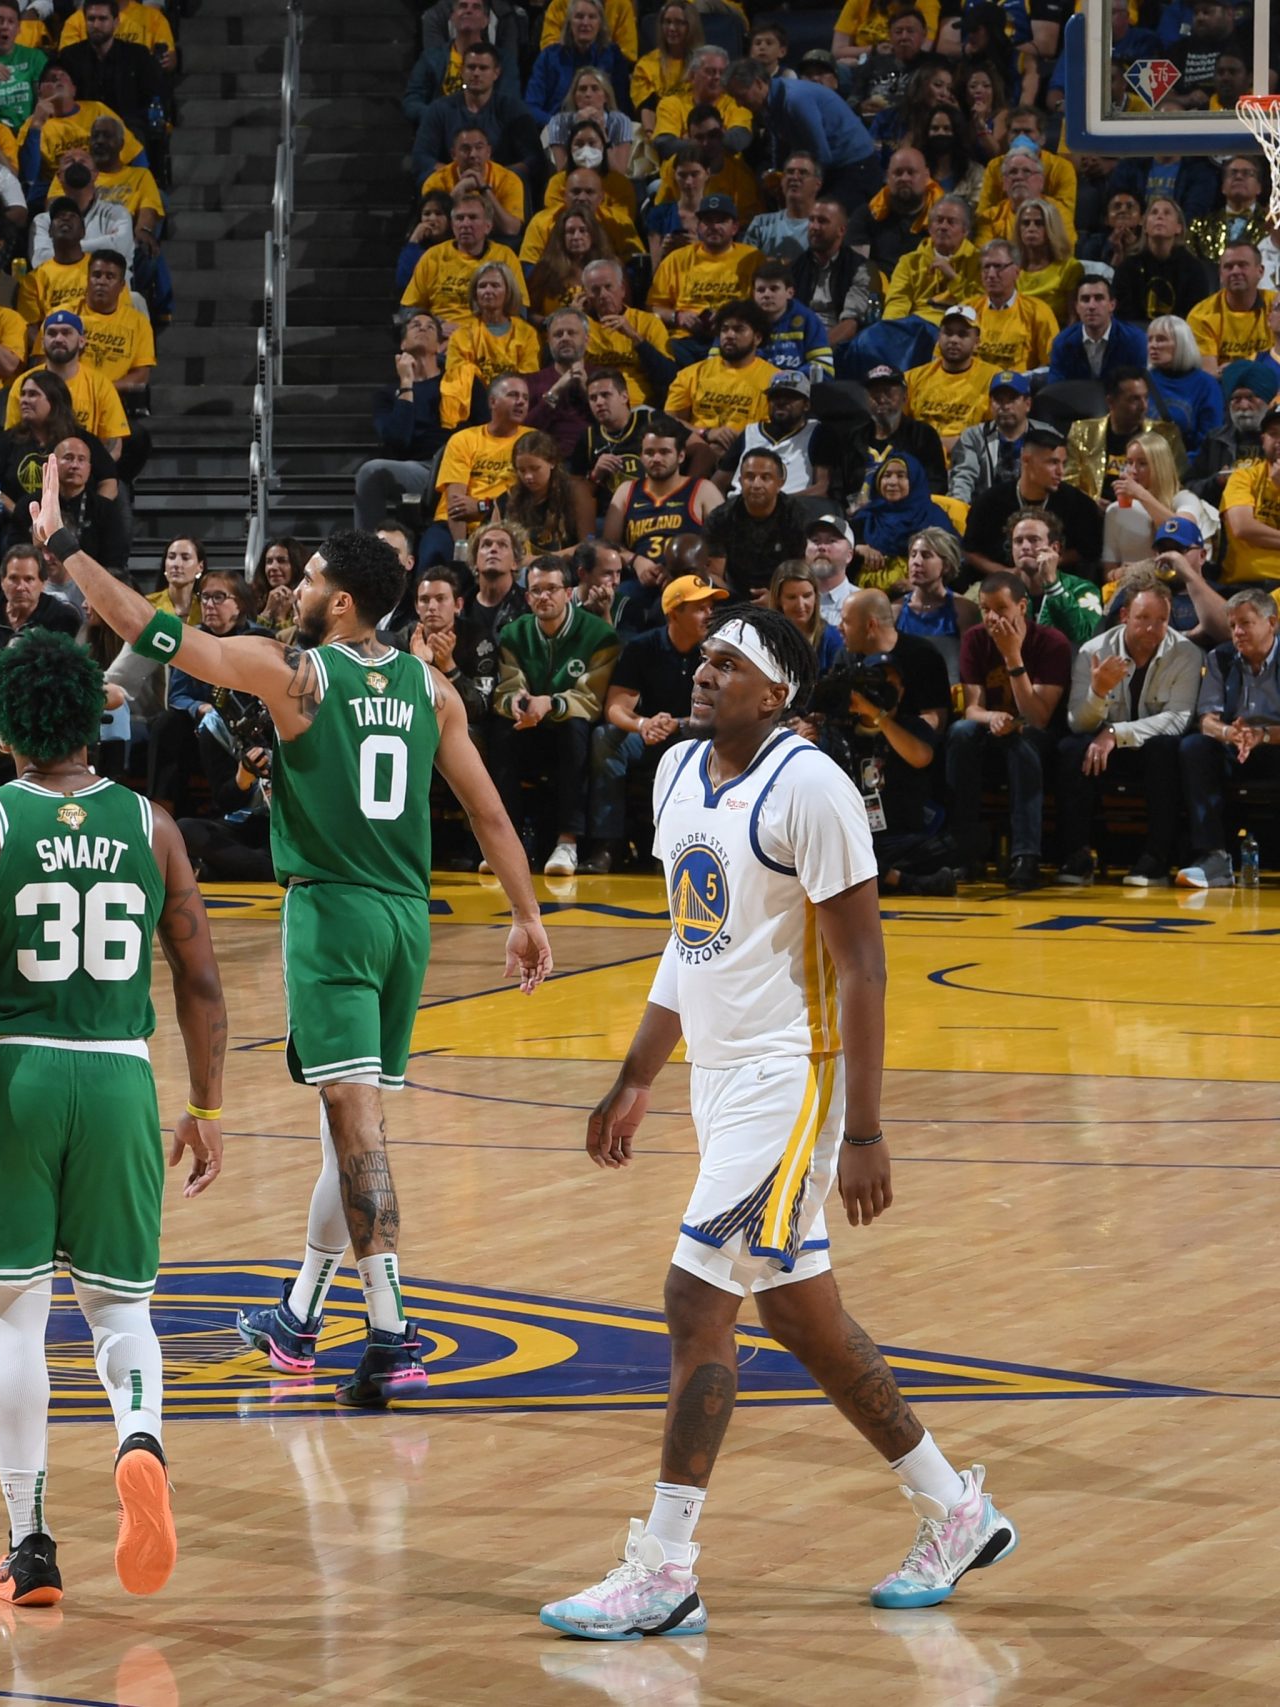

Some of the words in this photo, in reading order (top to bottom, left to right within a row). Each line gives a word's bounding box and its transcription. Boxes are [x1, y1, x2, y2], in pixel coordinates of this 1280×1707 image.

[703, 391, 753, 408] BLOODED
[349, 696, 415, 733] TATUM
[359, 734, 409, 821] 0
[35, 834, 129, 874] SMART
[670, 831, 707, 862] GOLDEN
[709, 834, 731, 871] STATE
[705, 873, 719, 901] 5
[14, 881, 146, 983] 36
[673, 929, 733, 965] ARRIORS
